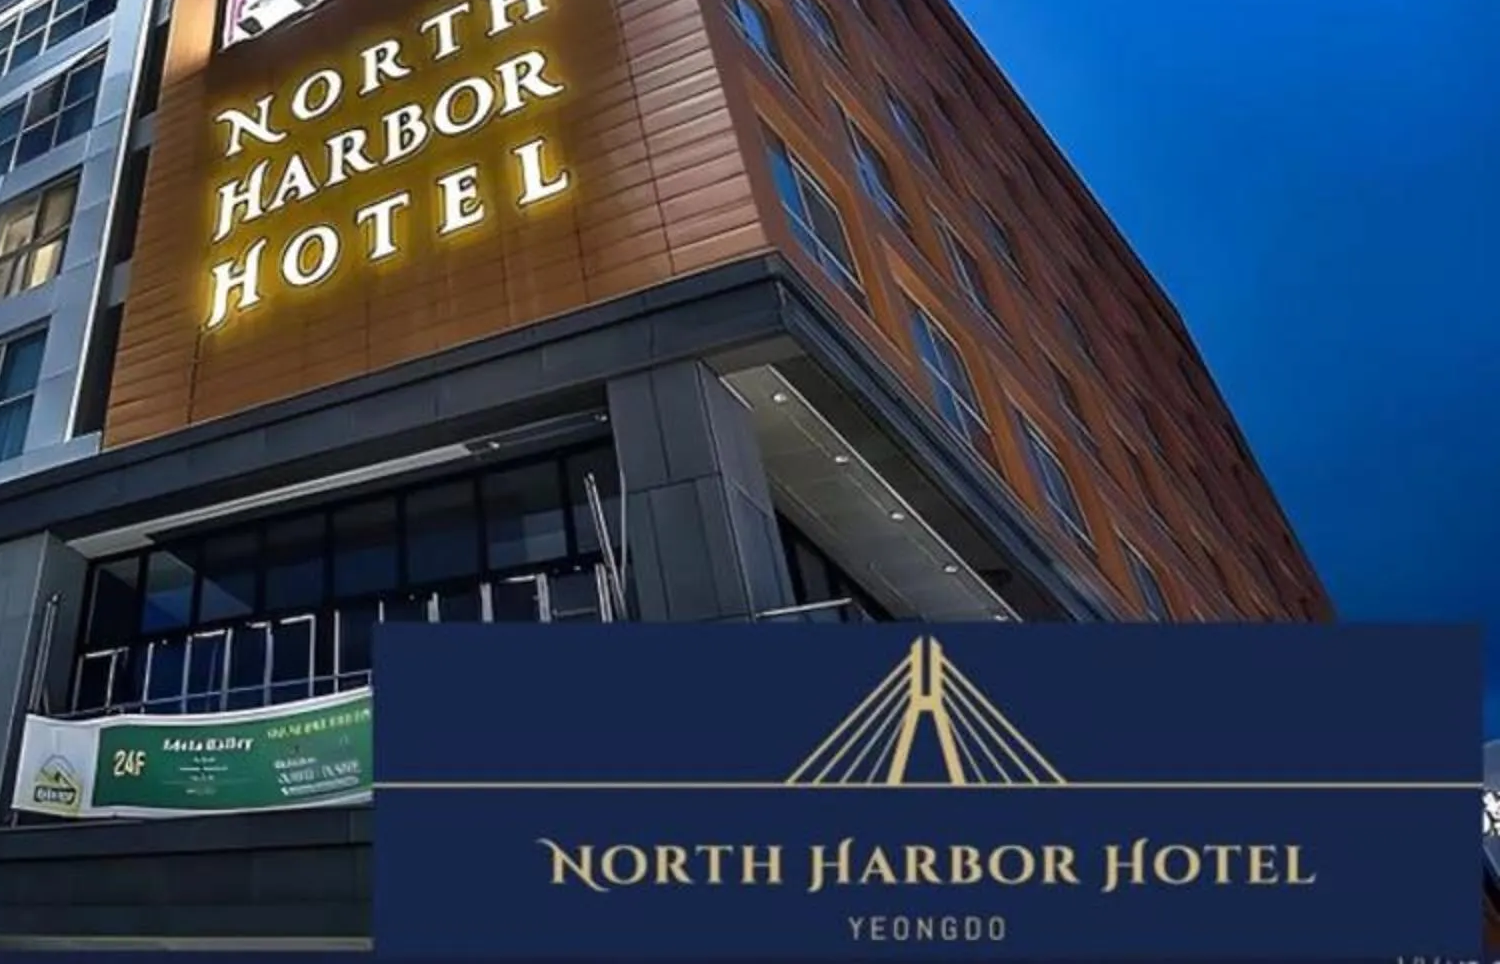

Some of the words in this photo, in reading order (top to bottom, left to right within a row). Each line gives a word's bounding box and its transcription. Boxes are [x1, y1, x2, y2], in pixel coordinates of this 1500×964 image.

[206, 139, 570, 329] HOTEL
[212, 49, 565, 244] HARBOR
[113, 749, 146, 777] 24F
